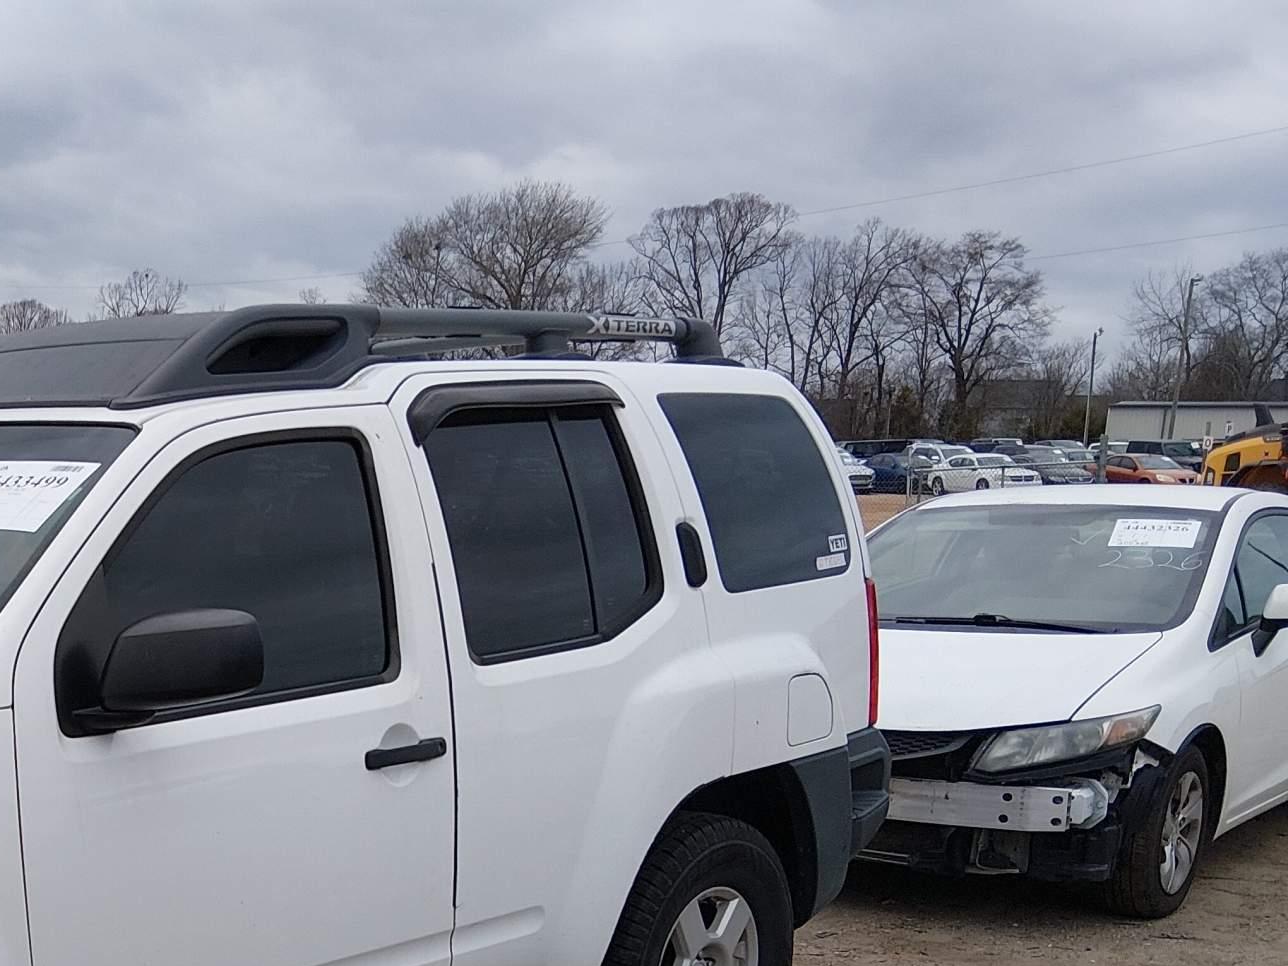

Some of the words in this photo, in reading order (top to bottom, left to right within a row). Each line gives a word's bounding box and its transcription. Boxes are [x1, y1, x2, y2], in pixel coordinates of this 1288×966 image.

[587, 314, 673, 337] XTERRA
[830, 537, 846, 550] YETI
[1097, 549, 1209, 572] 2326
